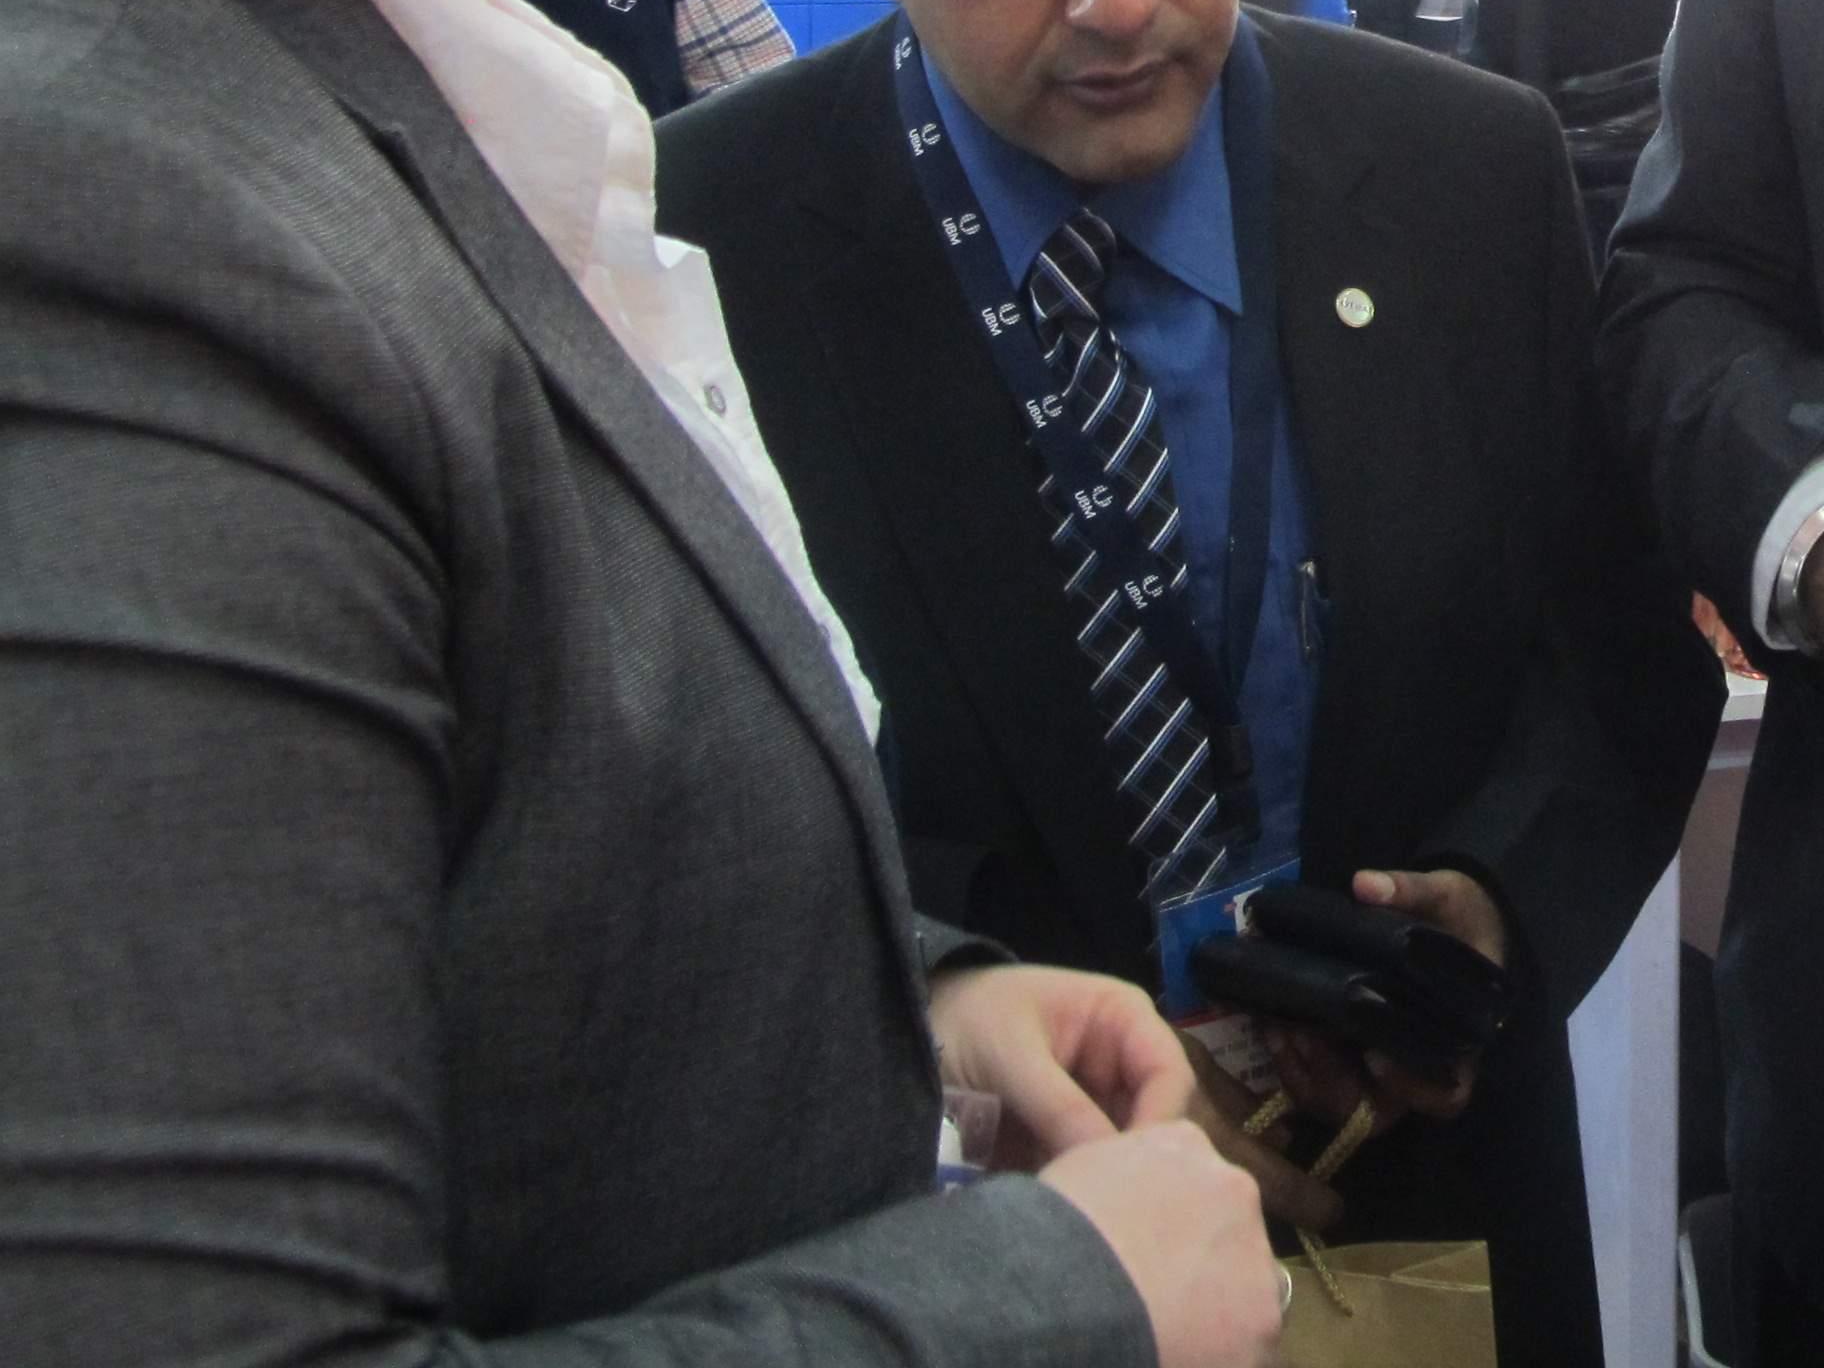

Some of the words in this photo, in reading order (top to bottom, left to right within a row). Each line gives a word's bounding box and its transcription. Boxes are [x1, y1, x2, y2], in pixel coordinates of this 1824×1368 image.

[942, 217, 962, 246] UBM
[981, 307, 1002, 336] UBM
[1025, 399, 1047, 429] UBM
[1074, 490, 1096, 519] UBM
[1124, 581, 1148, 609] UBM
